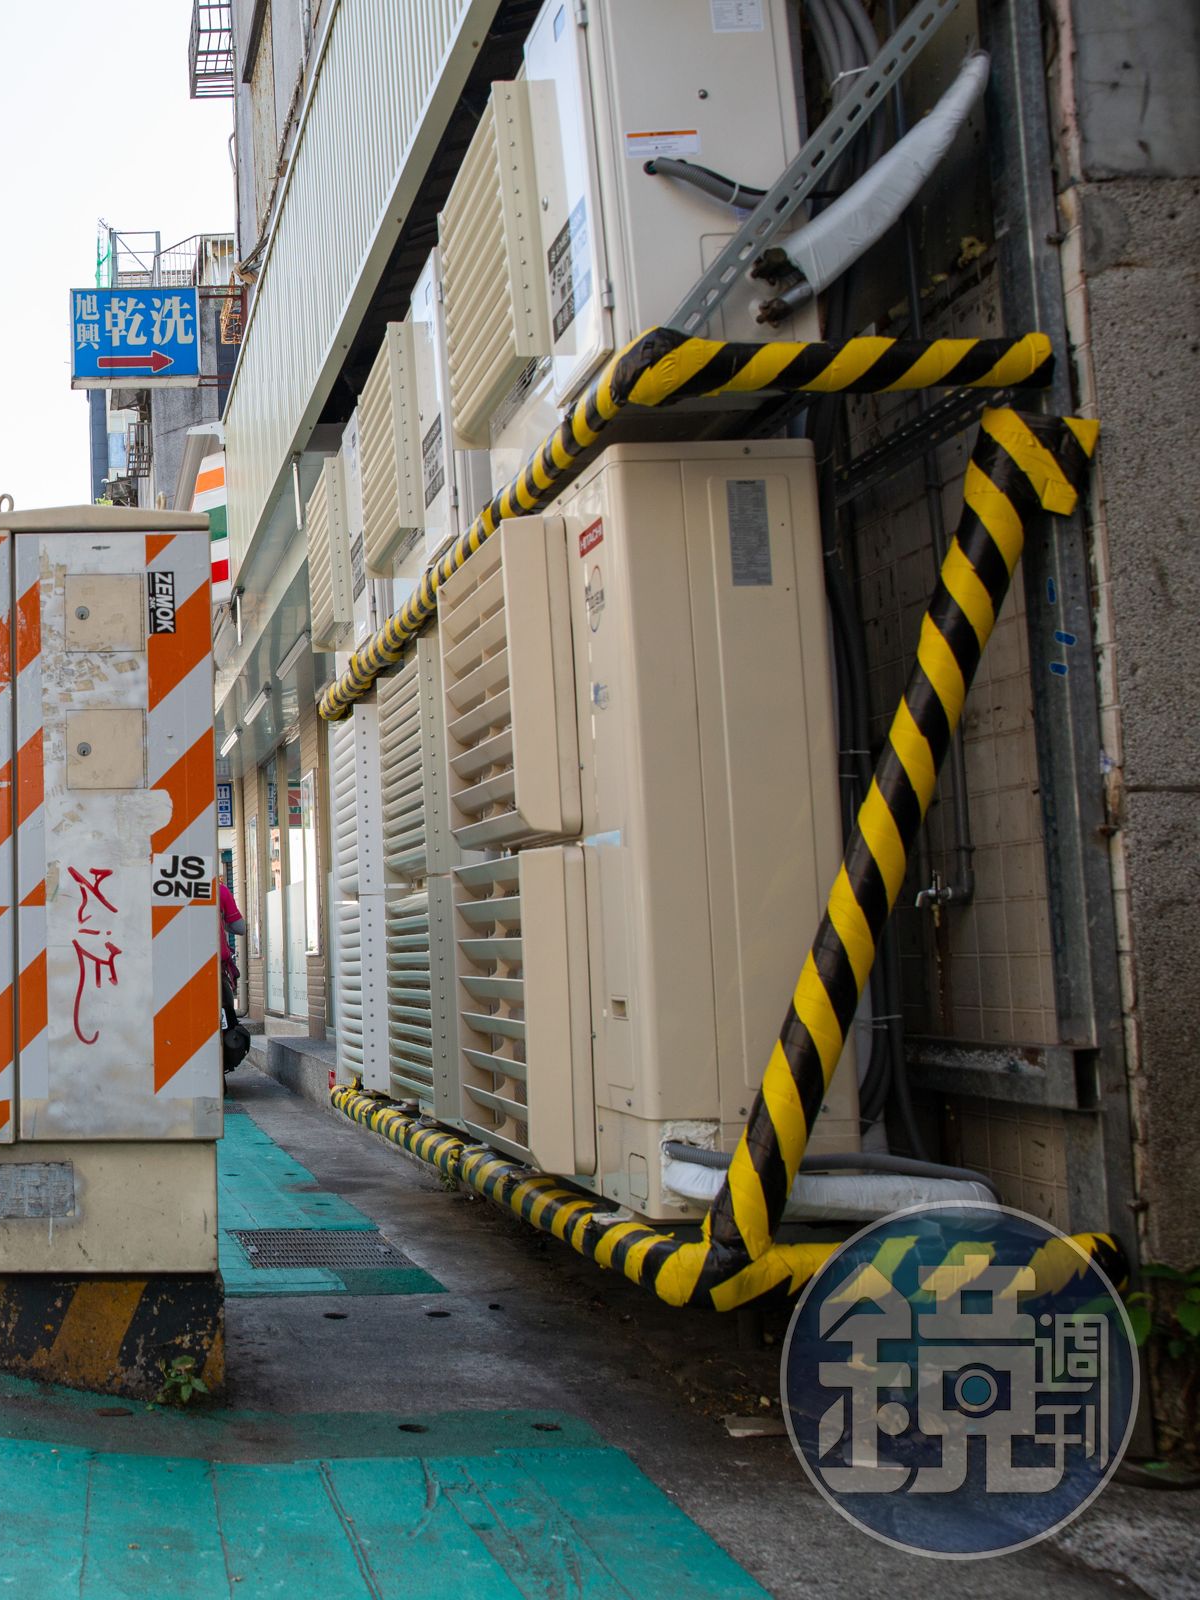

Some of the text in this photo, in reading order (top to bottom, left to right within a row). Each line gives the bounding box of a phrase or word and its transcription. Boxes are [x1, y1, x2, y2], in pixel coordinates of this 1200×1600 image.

[75, 294, 100, 350] 旭興
[104, 296, 194, 347] 乾洗
[154, 572, 175, 633] ZEMOK
[153, 880, 211, 899] ONE
[160, 855, 205, 880] JS
